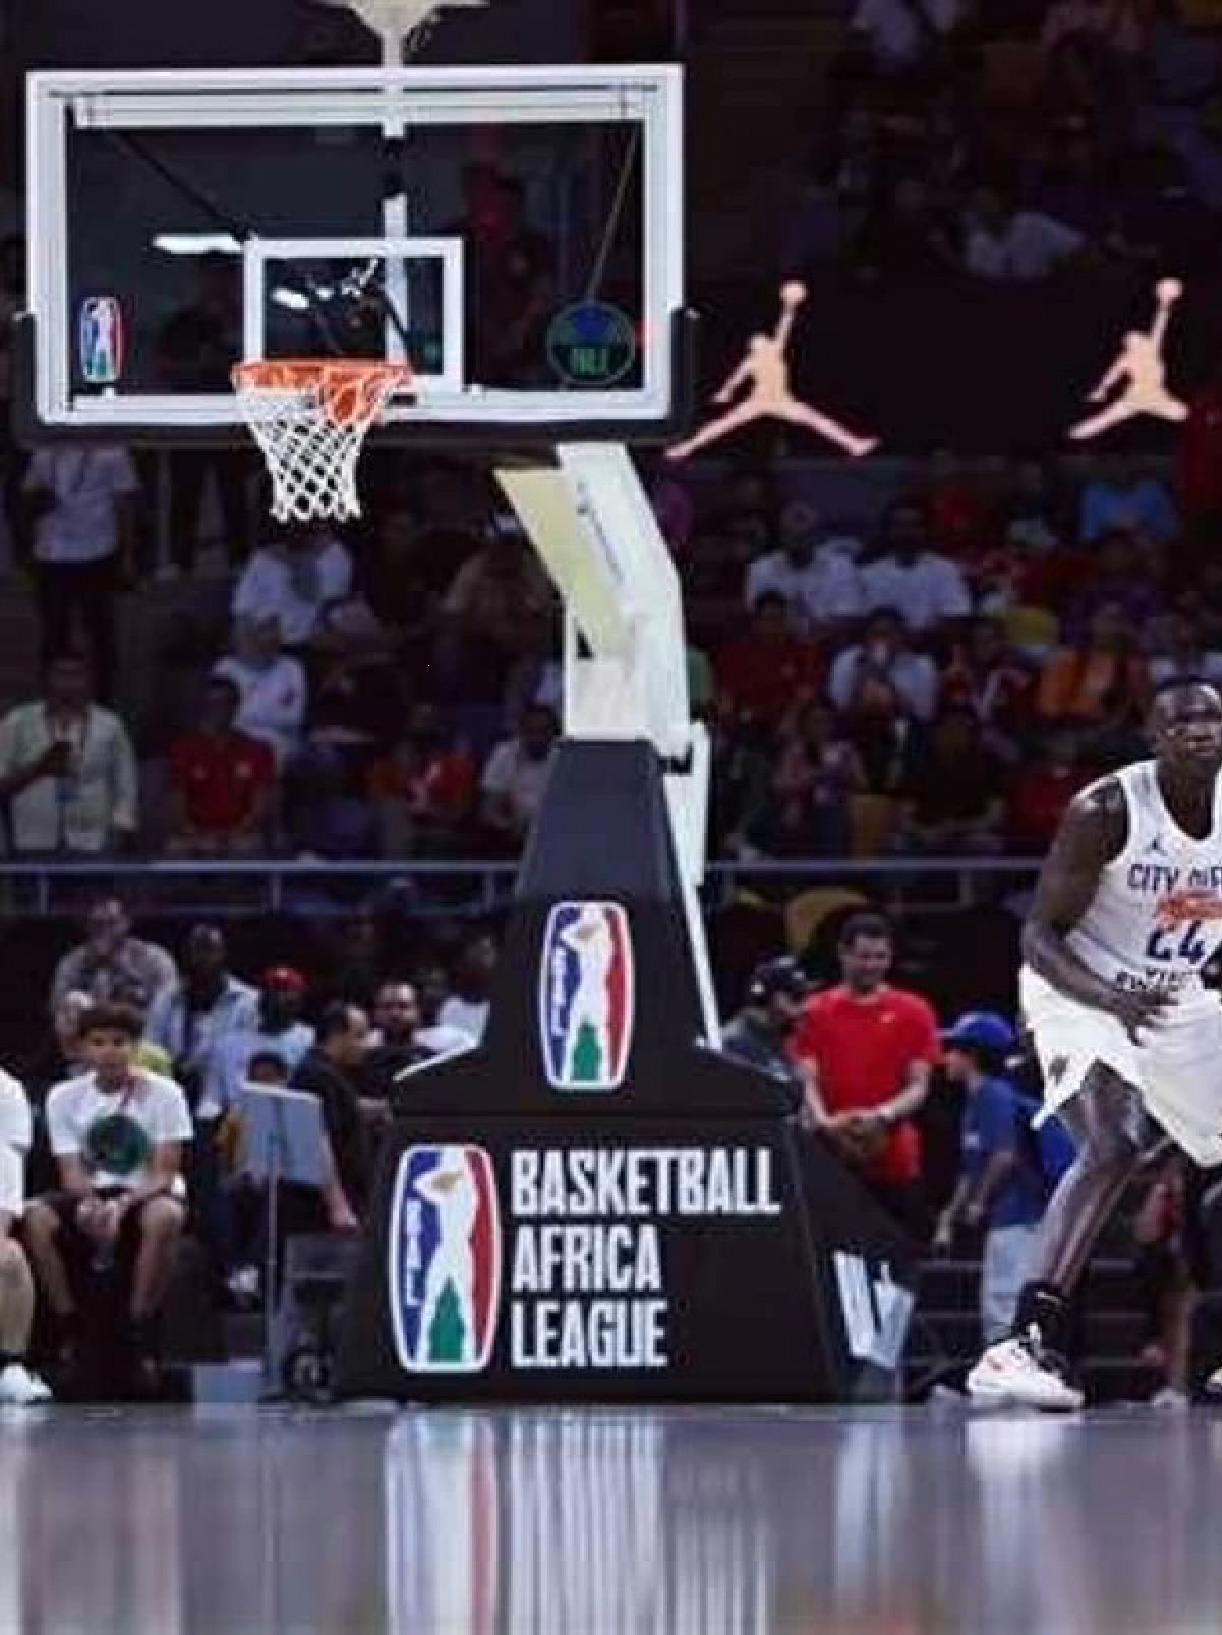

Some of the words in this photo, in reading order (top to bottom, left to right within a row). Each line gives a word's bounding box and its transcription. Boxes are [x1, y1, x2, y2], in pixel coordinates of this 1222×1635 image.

[1126, 863, 1179, 894] CITY
[510, 1148, 781, 1216] BASKETBALL
[512, 1224, 661, 1292] AFRICA
[511, 1300, 668, 1368] LEAGUE
